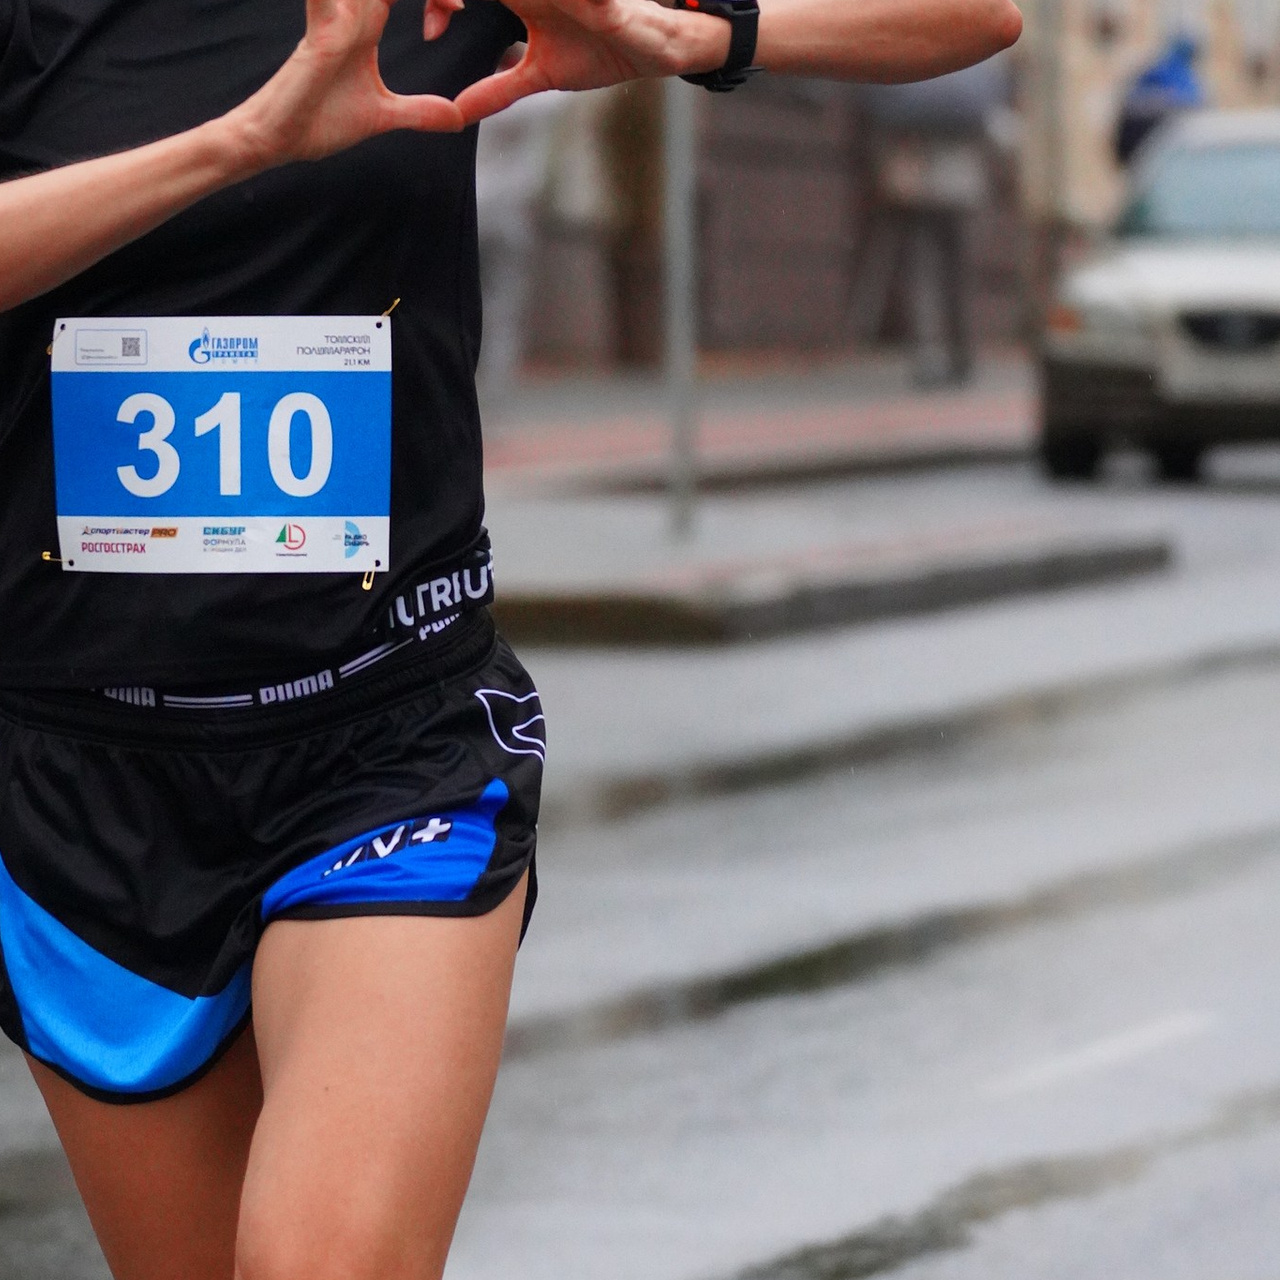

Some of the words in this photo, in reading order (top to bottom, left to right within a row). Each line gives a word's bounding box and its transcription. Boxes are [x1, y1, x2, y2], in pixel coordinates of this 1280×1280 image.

[211, 337, 258, 349] ГАЗПРОМ
[116, 392, 333, 498] 310
[81, 542, 146, 553] РОСГОССТРАХ
[259, 669, 334, 705] PUMA
